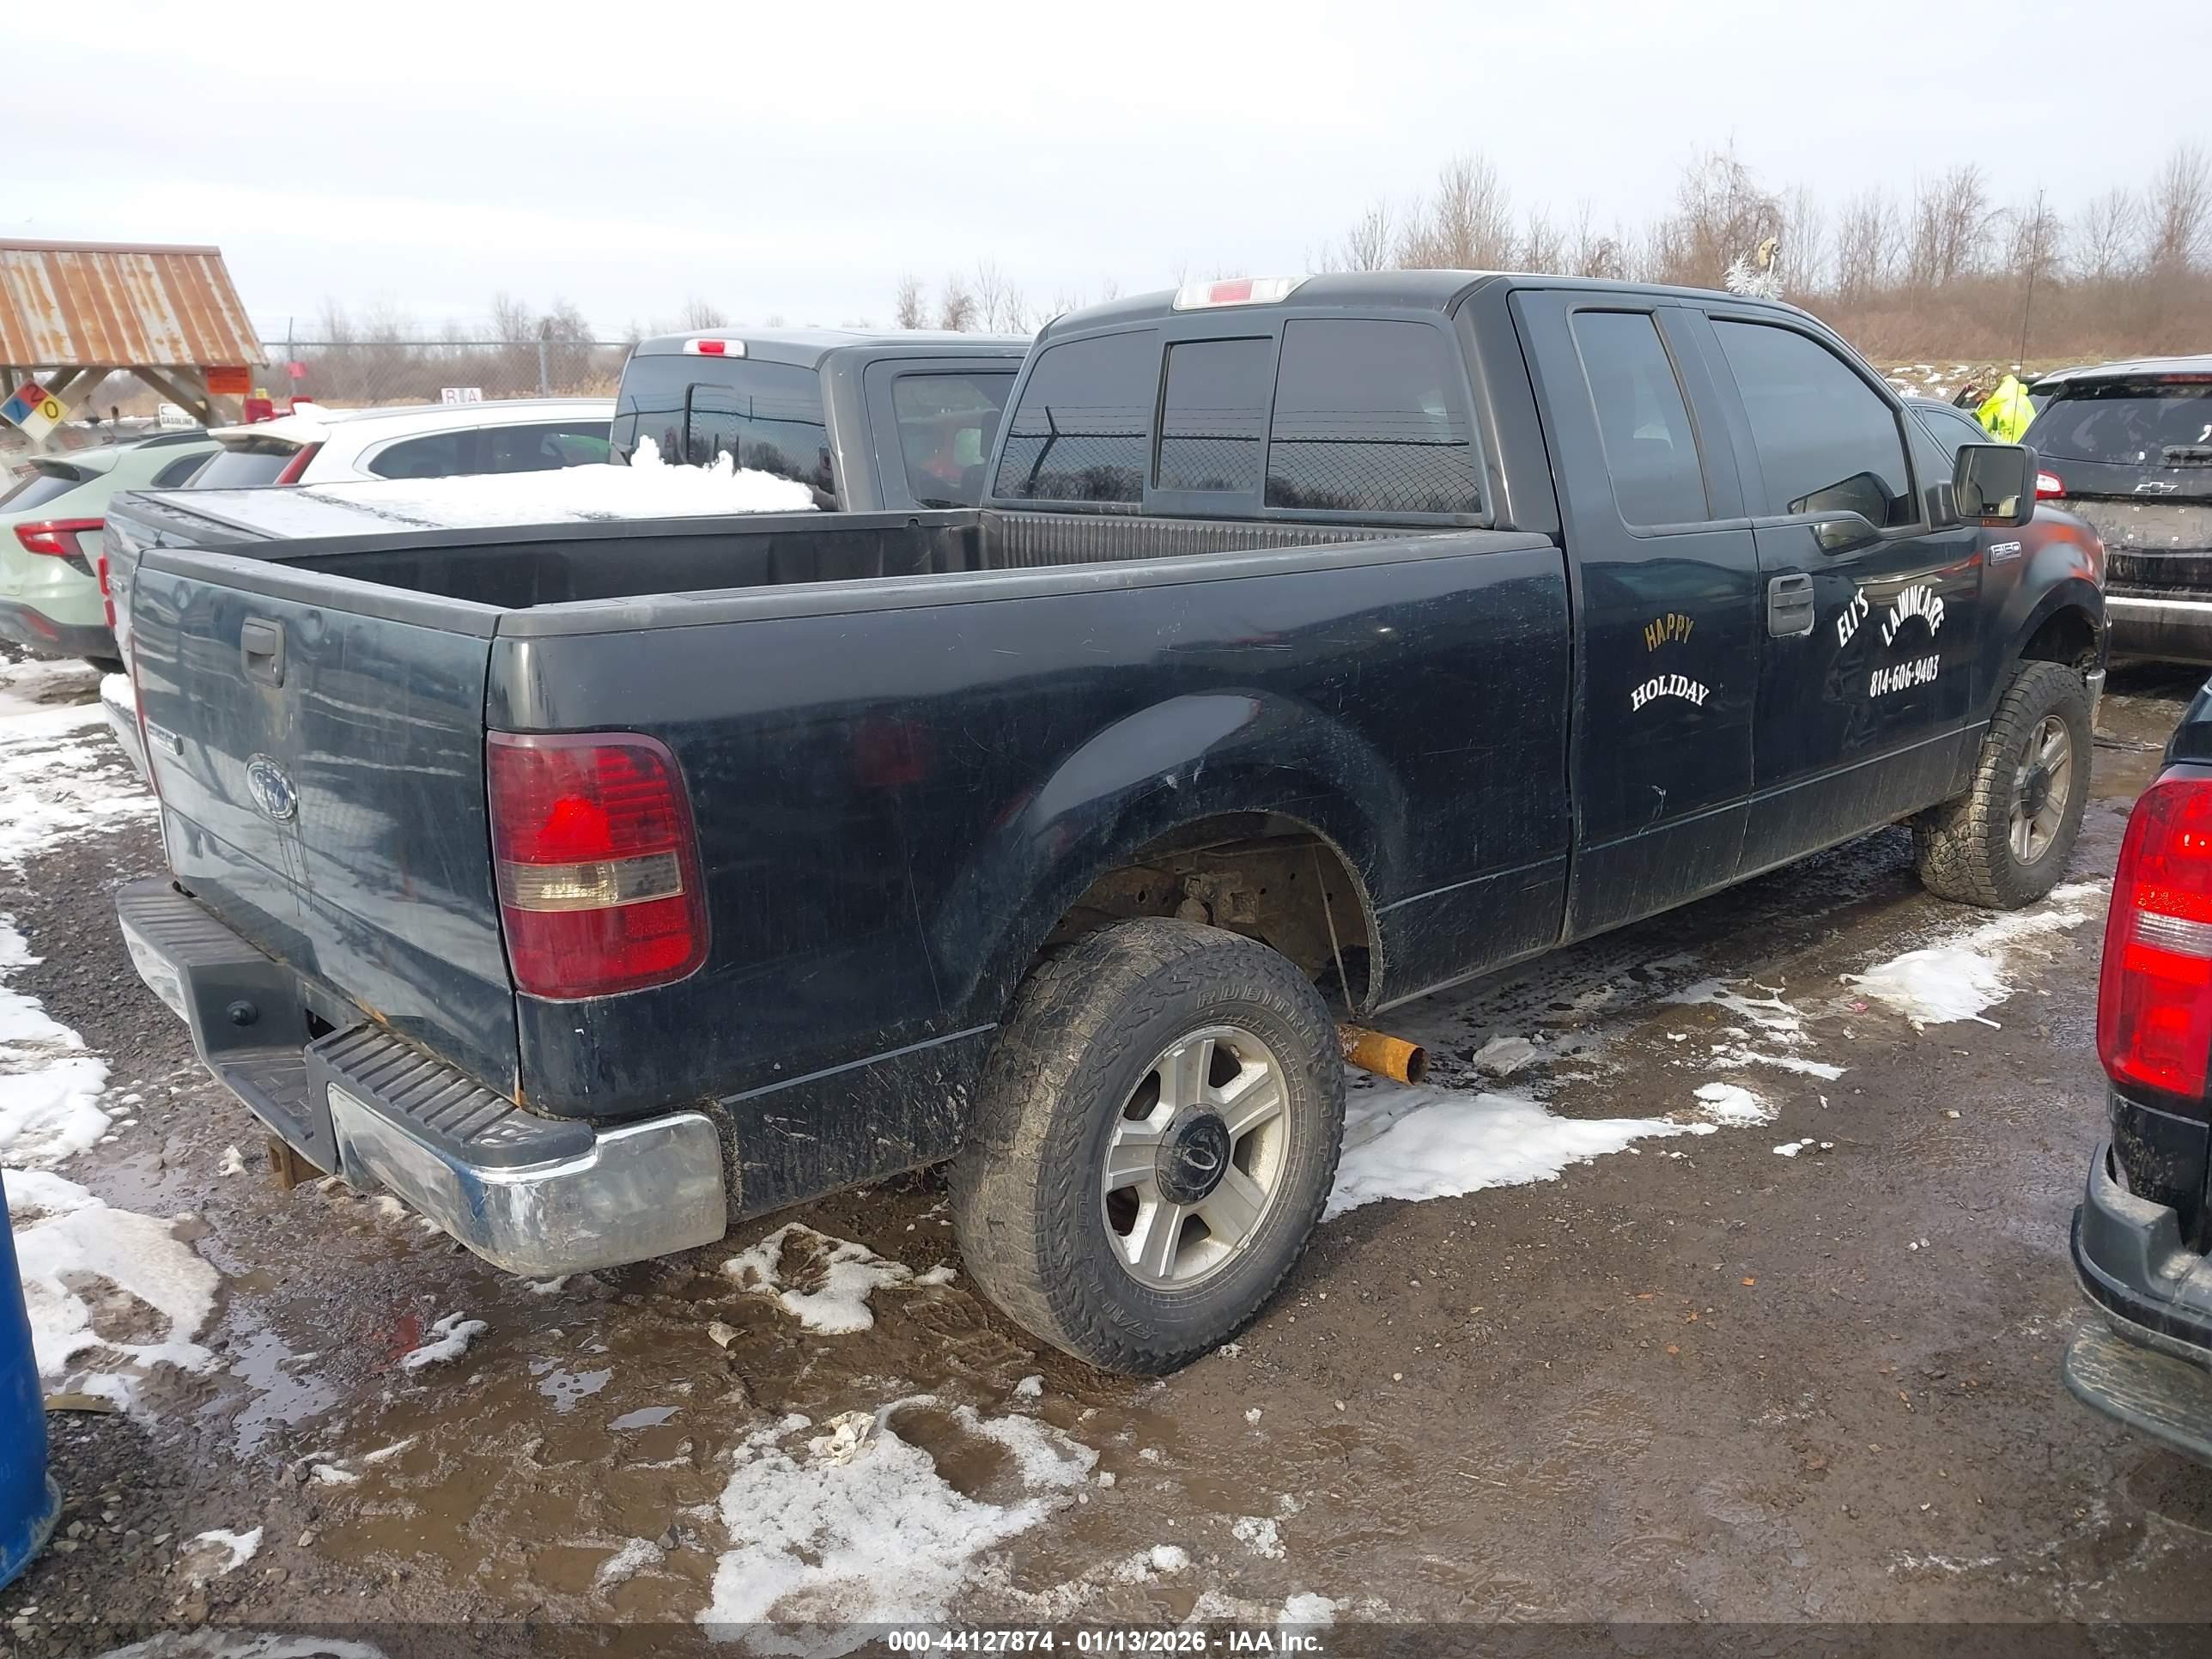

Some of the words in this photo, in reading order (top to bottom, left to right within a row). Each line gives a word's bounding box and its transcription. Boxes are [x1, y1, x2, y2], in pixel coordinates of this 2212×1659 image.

[27, 384, 45, 403] 2
[14, 400, 22, 418] 1
[44, 400, 58, 419] 0
[161, 416, 194, 427] GASOLINE
[1837, 586, 1869, 648] ELI'S
[1881, 585, 1945, 647] LAWNCARE
[1644, 612, 1694, 653] HAPPY
[1869, 654, 1941, 698] 814-606-9403
[1631, 673, 1711, 712] HOLIDAY
